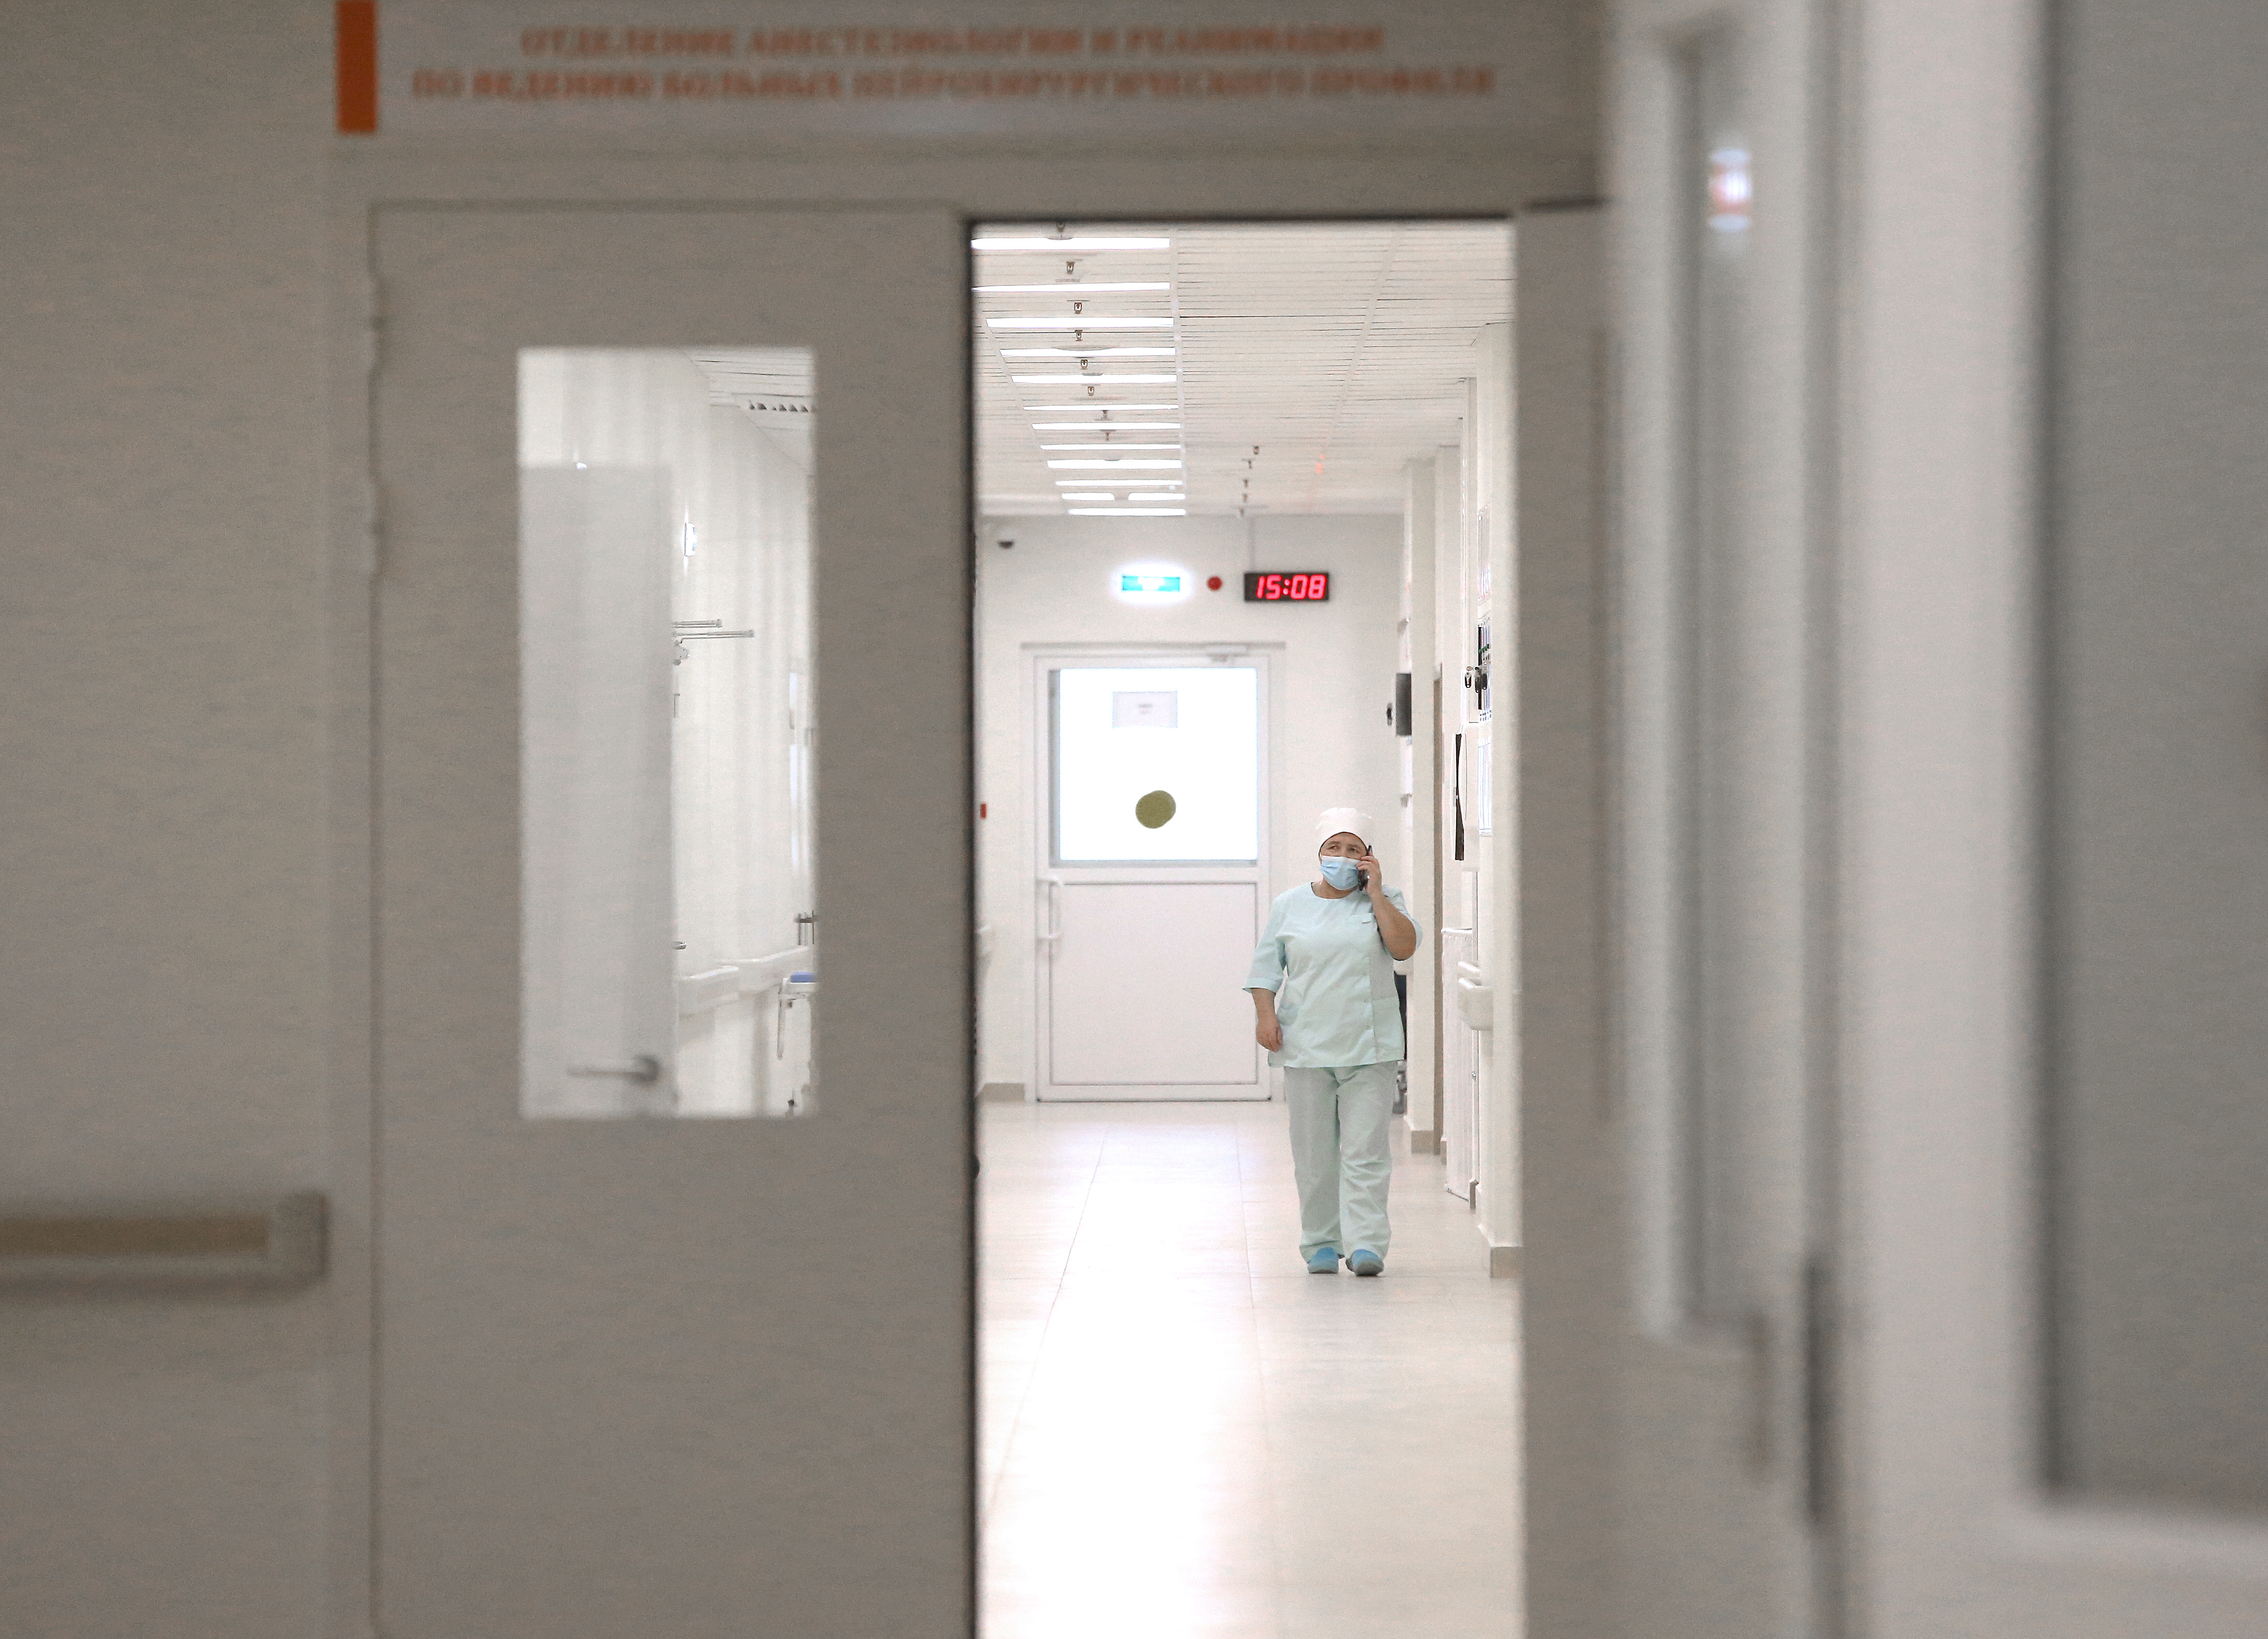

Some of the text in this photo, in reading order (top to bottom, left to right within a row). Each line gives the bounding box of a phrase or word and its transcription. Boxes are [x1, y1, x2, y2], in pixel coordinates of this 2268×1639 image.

[520, 26, 736, 57] ОТДЕЛЕНИЕ
[748, 25, 1081, 57] АНЕСТЕЗИОЛОГИИ
[411, 70, 462, 101] ПО
[472, 70, 654, 101] ВЕДЕНИЮ
[662, 70, 843, 101] БОЛЬНЫХ
[1256, 574, 1327, 600] 15:08
